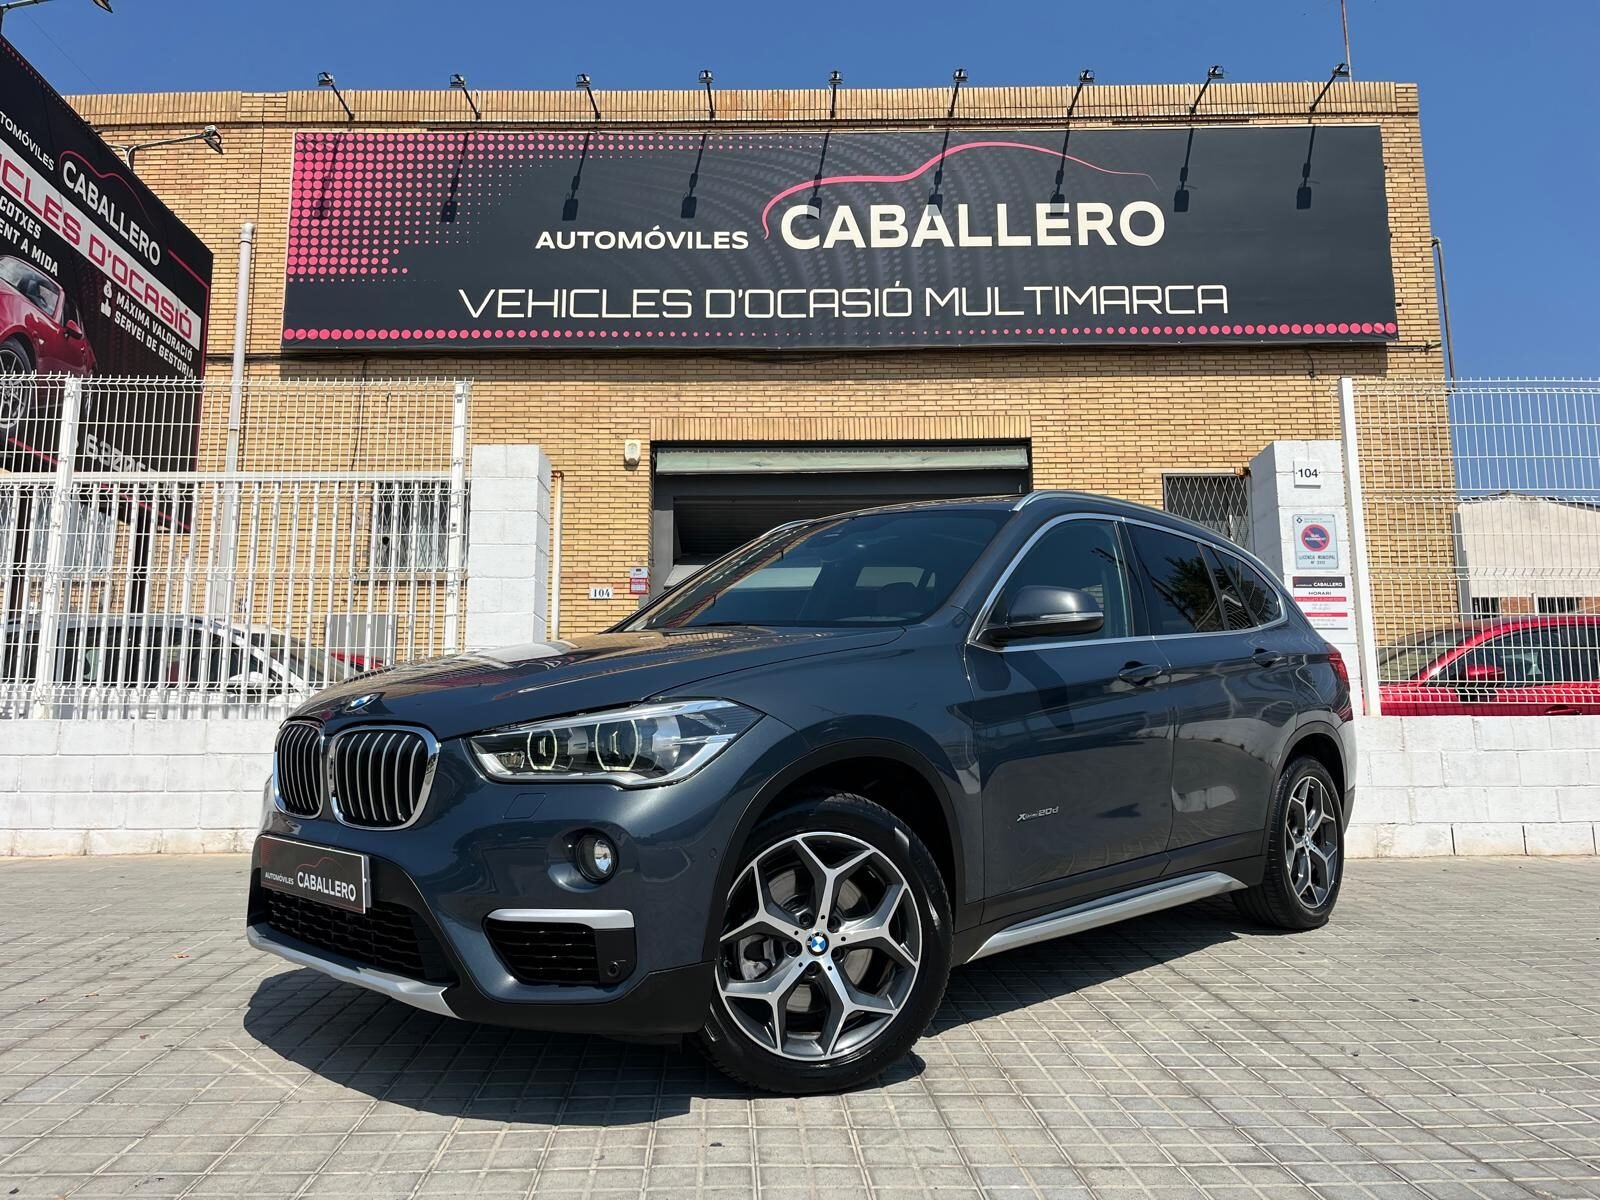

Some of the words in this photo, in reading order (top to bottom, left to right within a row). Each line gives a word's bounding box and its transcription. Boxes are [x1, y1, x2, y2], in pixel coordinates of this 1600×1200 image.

[63, 160, 160, 266] CABALLERO
[535, 225, 749, 250] AUTOMÓVILES
[780, 200, 1165, 250] CABALLERO
[21, 238, 29, 254] A
[31, 245, 58, 277] MIDA
[88, 233, 192, 340] D'OCASIÓ
[458, 288, 693, 319] VEHICLES
[705, 281, 912, 319] D'OCASIÓ
[925, 284, 1229, 317] MULTIMARCA
[114, 311, 145, 342] SERVEI
[146, 335, 157, 352] DE
[159, 345, 194, 379] GESTORIA
[152, 321, 193, 362] VALORACIÓ
[1298, 468, 1319, 478] 104
[593, 588, 610, 598] 104
[265, 871, 295, 885] AUTOMÓVILES
[297, 871, 357, 902] CABALLERO
